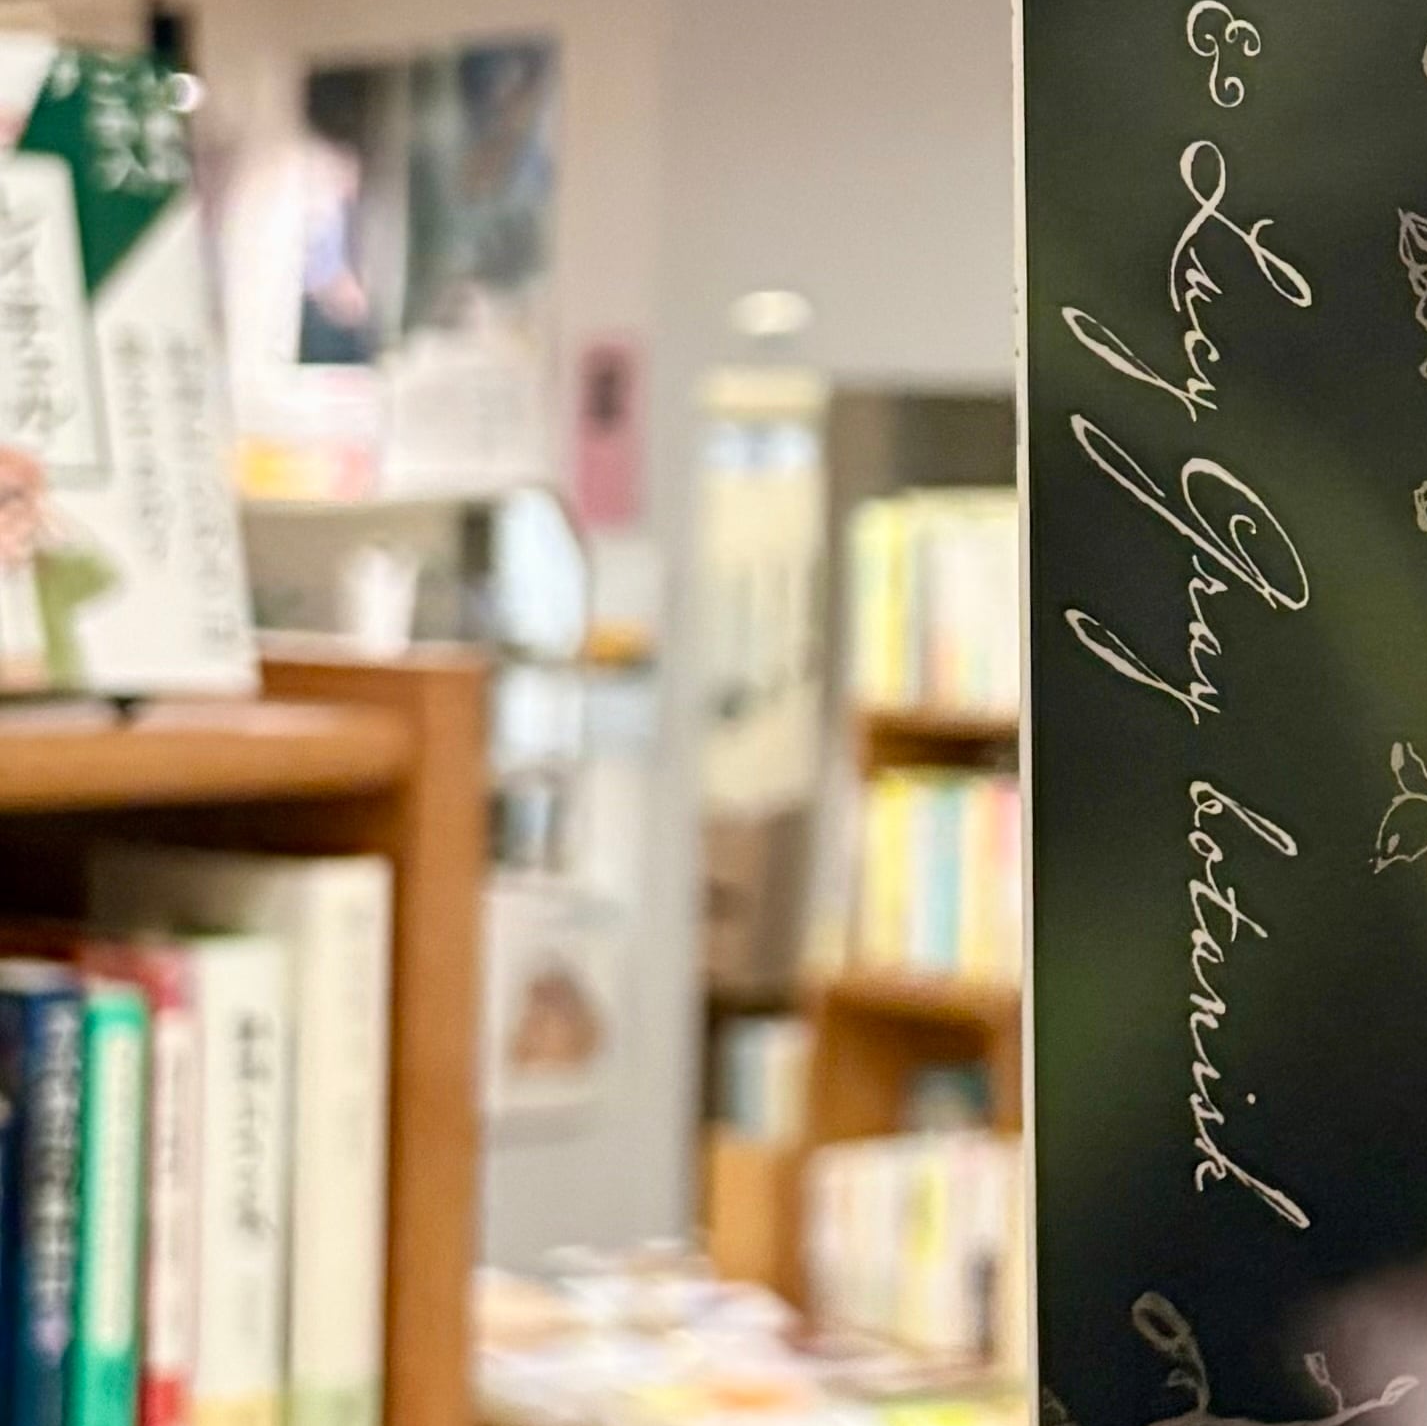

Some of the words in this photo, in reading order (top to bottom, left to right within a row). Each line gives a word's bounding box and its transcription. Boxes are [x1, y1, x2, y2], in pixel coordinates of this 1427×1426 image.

[1186, 0, 1263, 110] &
[1060, 139, 1313, 423] Lucy
[1065, 413, 1311, 727] Gray
[1188, 779, 1312, 1231] botanisk
